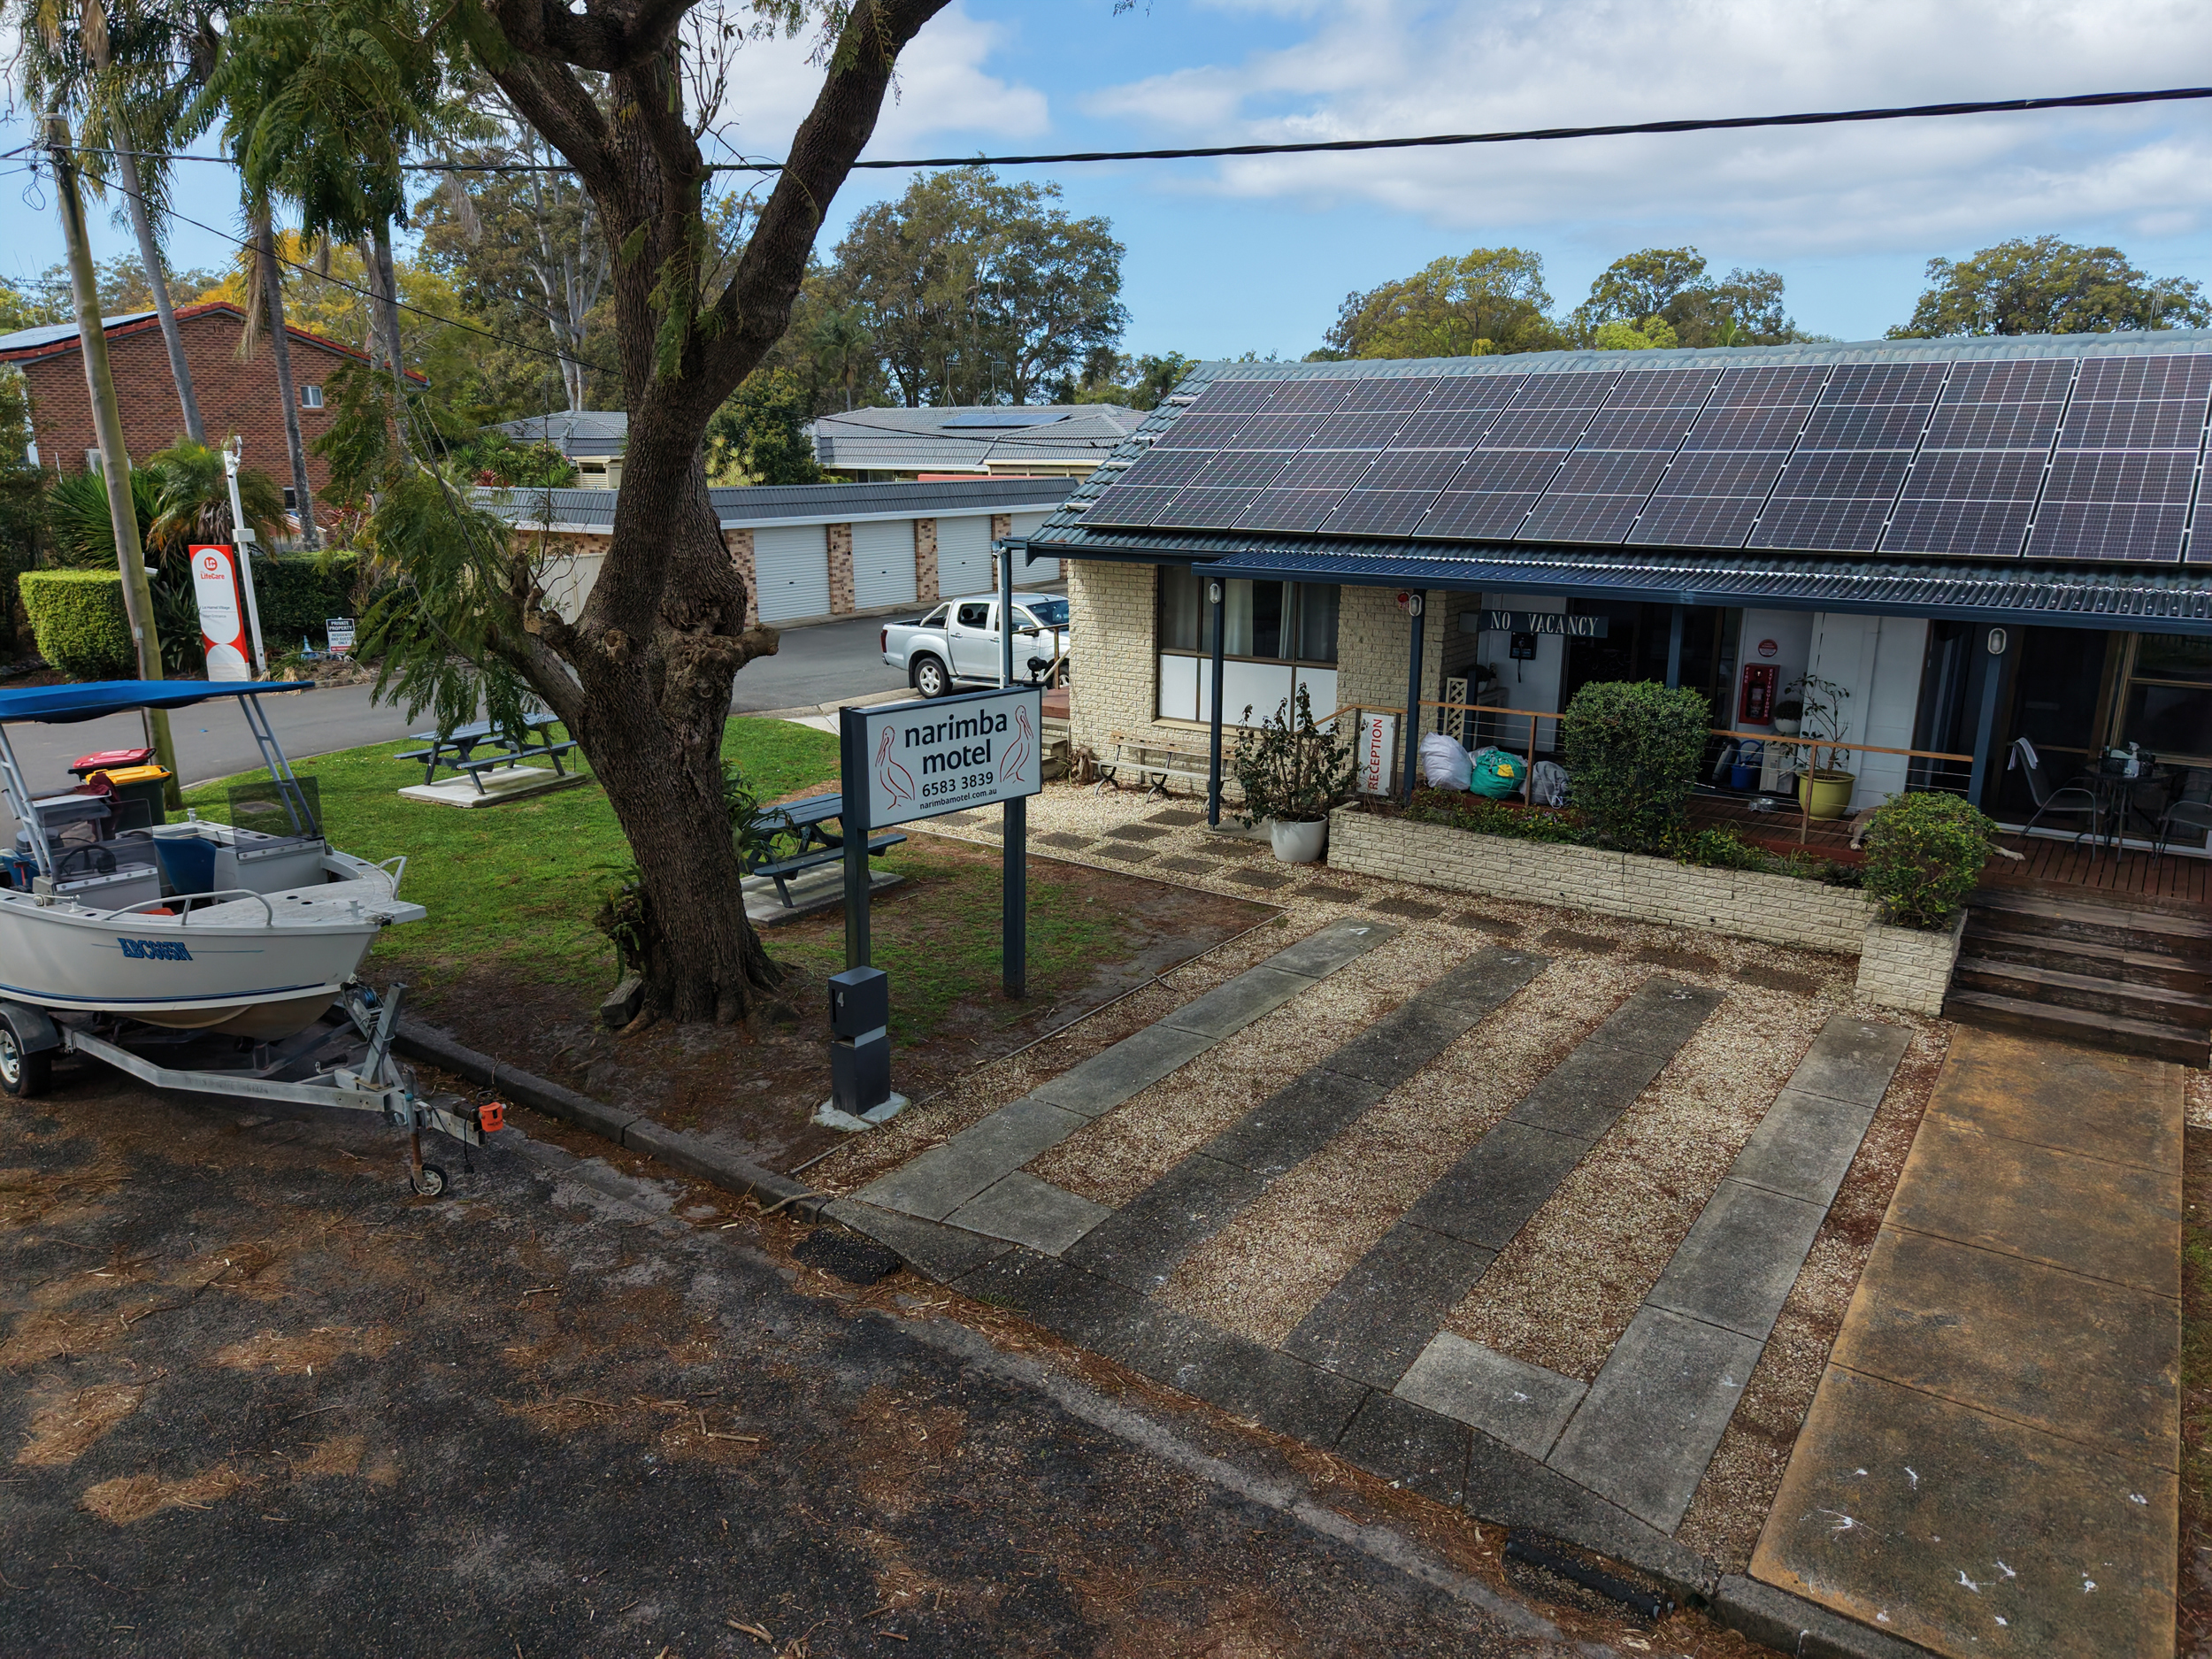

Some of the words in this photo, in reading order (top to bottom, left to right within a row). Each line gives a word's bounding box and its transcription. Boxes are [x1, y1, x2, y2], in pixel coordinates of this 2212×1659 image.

[1490, 611, 1511, 630] NO
[1528, 613, 1599, 636] VACANCY
[1763, 668, 1773, 718] EXTINGUISHER
[904, 709, 1008, 749] narimba
[922, 738, 992, 775] motel
[1367, 718, 1384, 791] RECEPTION
[919, 787, 997, 810] narimbamotel.com.au
[922, 778, 956, 797] 6583
[961, 771, 994, 790] 3839
[837, 992, 844, 1007] 4
